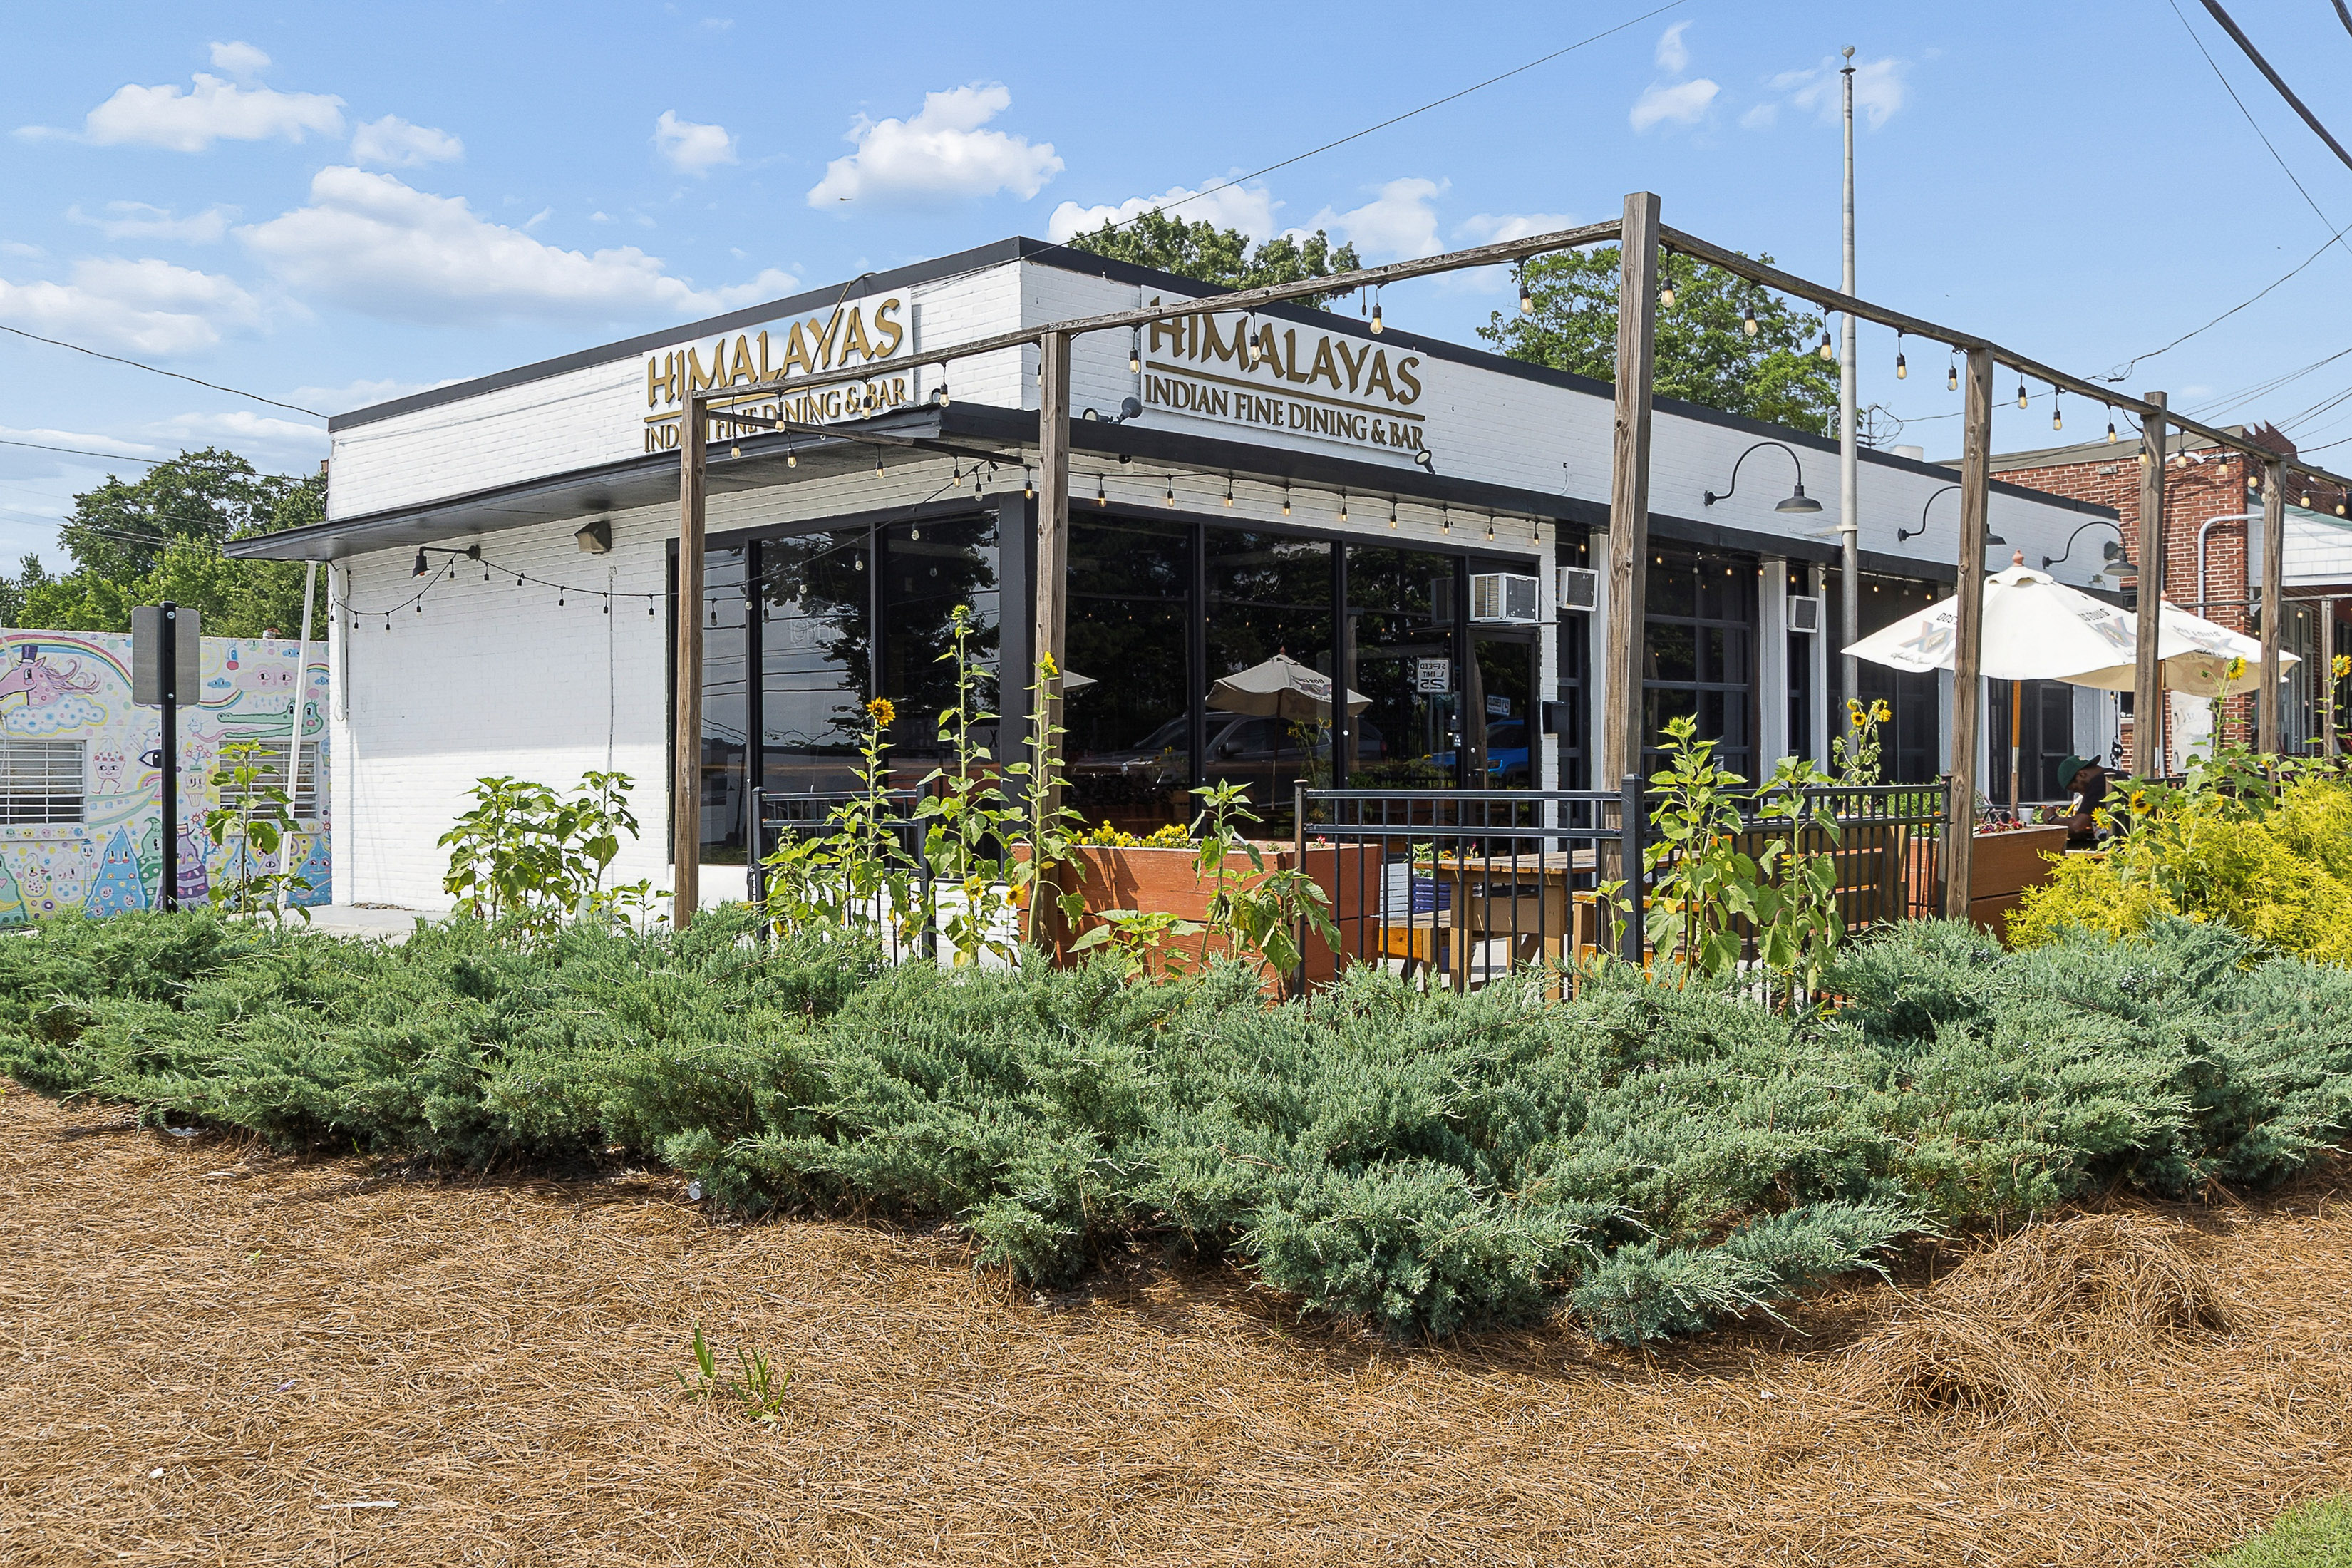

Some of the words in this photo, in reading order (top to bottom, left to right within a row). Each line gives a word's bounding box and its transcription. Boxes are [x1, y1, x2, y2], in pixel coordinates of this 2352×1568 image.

[648, 298, 903, 407] HIMALAYAS
[845, 386, 862, 414] &
[867, 378, 906, 411] BAR
[1150, 296, 1422, 406] HIMALAYAS
[1145, 373, 1229, 417] INDIAN
[1234, 392, 1284, 426] FINE
[1289, 402, 1367, 441] DINING
[1371, 419, 1387, 445] &
[1390, 421, 1425, 450] BAR
